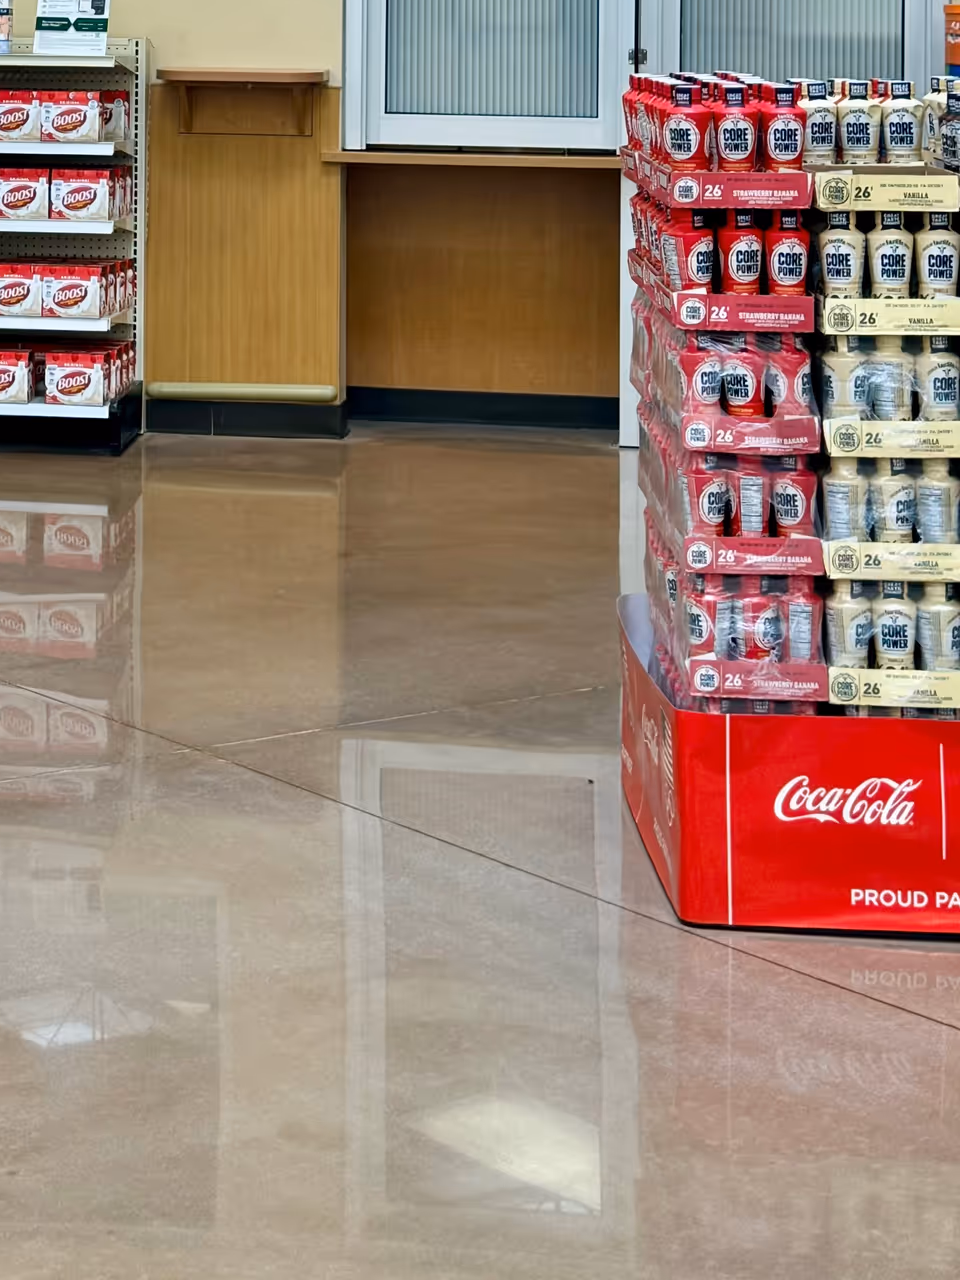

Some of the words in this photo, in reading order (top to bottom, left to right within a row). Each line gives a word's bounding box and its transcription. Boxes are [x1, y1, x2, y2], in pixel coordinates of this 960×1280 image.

[52, 110, 87, 127] BOOST
[669, 128, 691, 140] CORE
[723, 128, 748, 141] CORE
[774, 128, 798, 141] CORE
[811, 122, 833, 134] CORE
[846, 122, 870, 135] CORE
[889, 122, 914, 135] CORE
[724, 140, 748, 152] POWER
[811, 134, 833, 145] POWER
[847, 134, 870, 146] POWER
[890, 134, 914, 145] POWER
[670, 140, 692, 153] POWER
[774, 141, 797, 153] POWER
[1, 188, 36, 204] BOOST
[778, 252, 803, 265] CORE
[881, 253, 906, 267] CORE
[778, 265, 803, 277] POWER
[881, 266, 906, 278] POWER
[53, 285, 88, 303] BOOST
[739, 312, 778, 320] STRAWBERRY
[779, 313, 804, 321] BANANA
[56, 372, 91, 389] BOOST
[933, 377, 957, 390] CORE
[933, 390, 957, 401] POWER
[881, 624, 907, 638] CORE
[882, 638, 908, 649] POWER
[773, 774, 923, 826] Coca-Cola
[850, 888, 928, 908] PROUD
